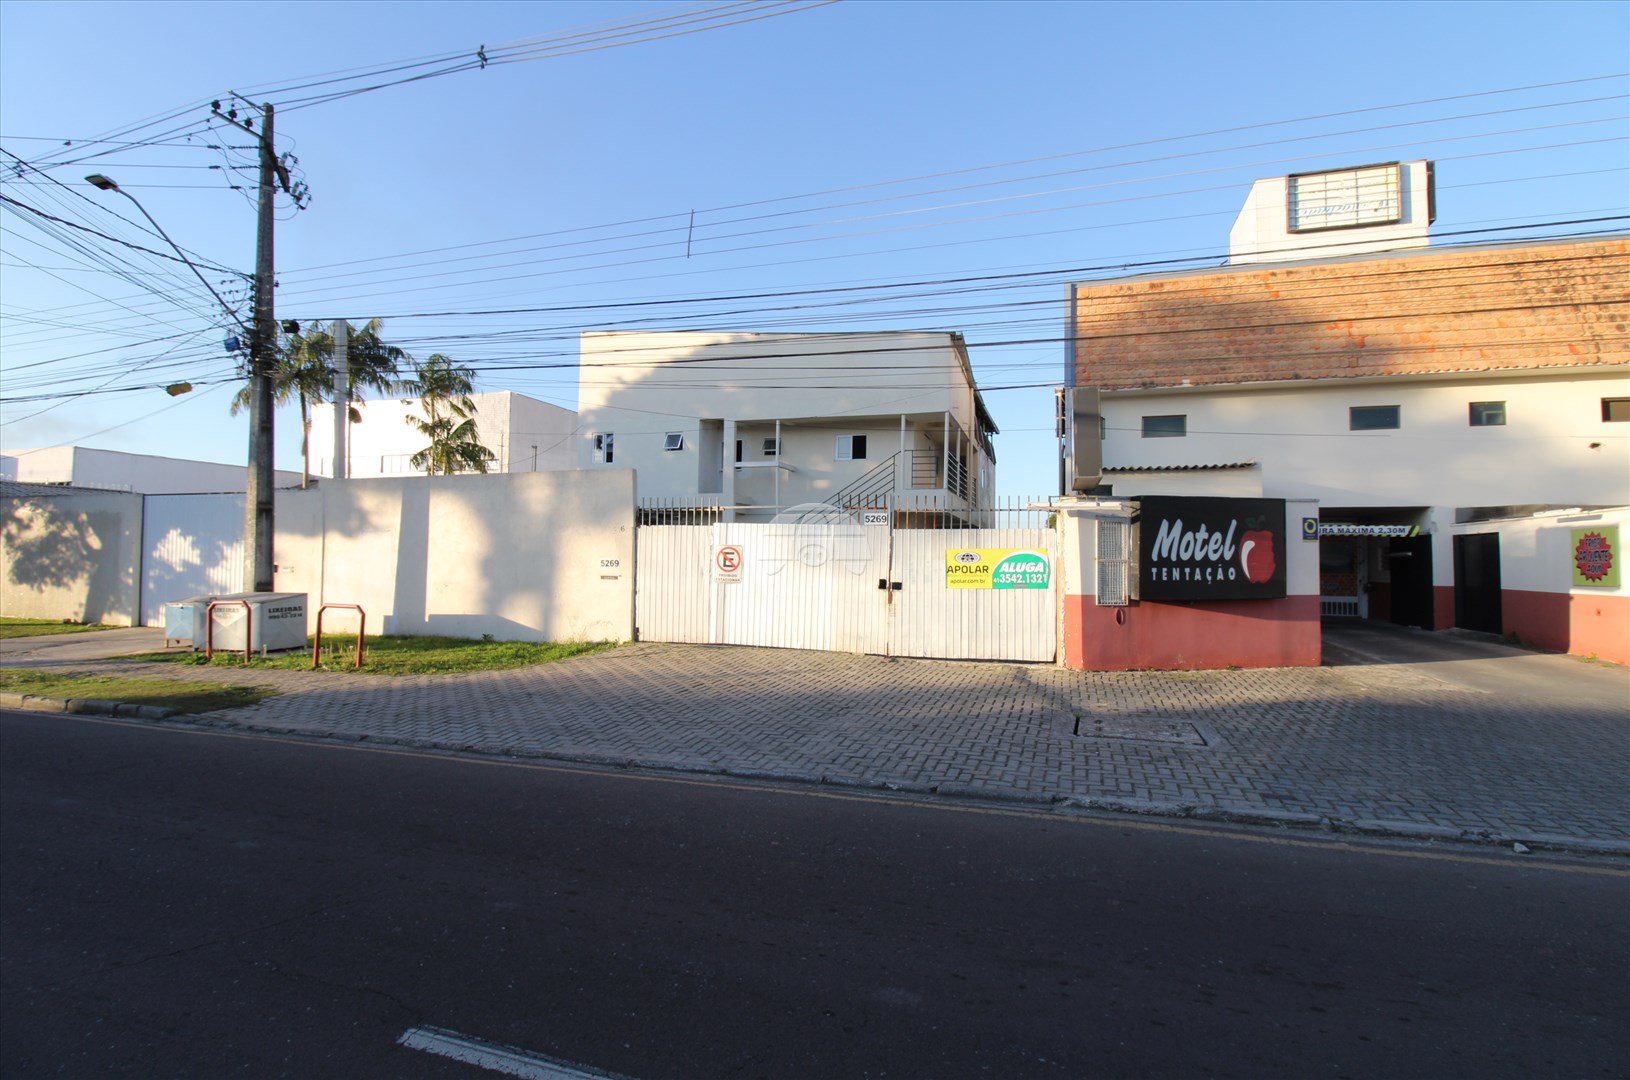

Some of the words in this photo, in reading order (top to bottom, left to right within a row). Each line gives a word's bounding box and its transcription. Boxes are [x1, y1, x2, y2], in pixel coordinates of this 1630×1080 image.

[865, 515, 886, 523] 5269
[1151, 518, 1237, 562] Motel
[600, 559, 620, 567] 5269
[999, 562, 1044, 573] ALUGA
[947, 565, 989, 574] APOLAR
[1151, 564, 1236, 584] TENTAÇÃO
[1000, 573, 1047, 584] 3542.1321
